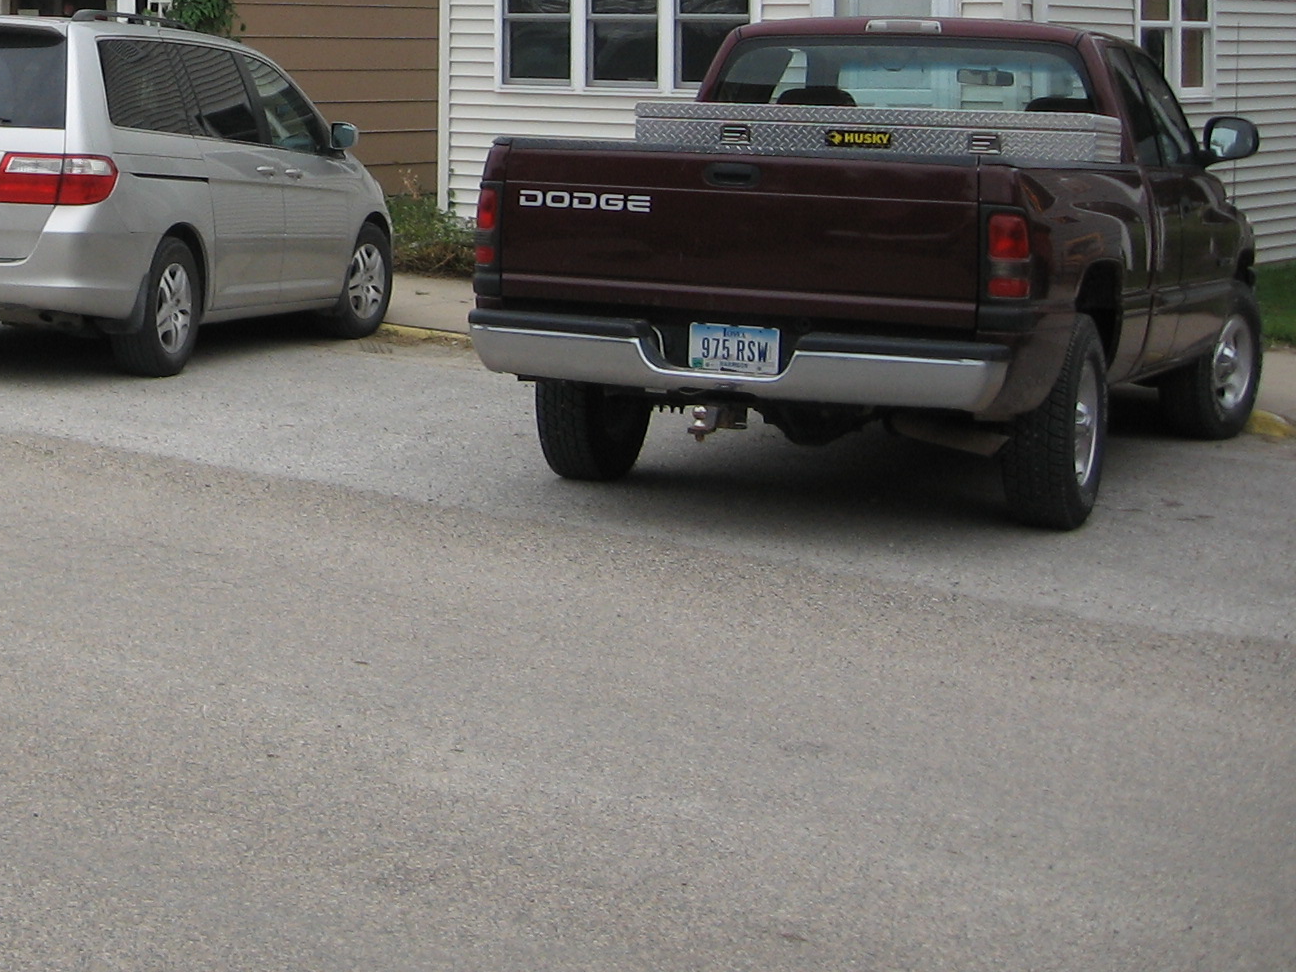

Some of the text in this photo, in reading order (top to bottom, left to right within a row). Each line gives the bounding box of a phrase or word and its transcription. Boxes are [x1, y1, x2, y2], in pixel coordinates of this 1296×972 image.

[844, 132, 890, 145] HUSKY
[518, 189, 652, 213] DODGE
[702, 337, 769, 363] 975 RSW
